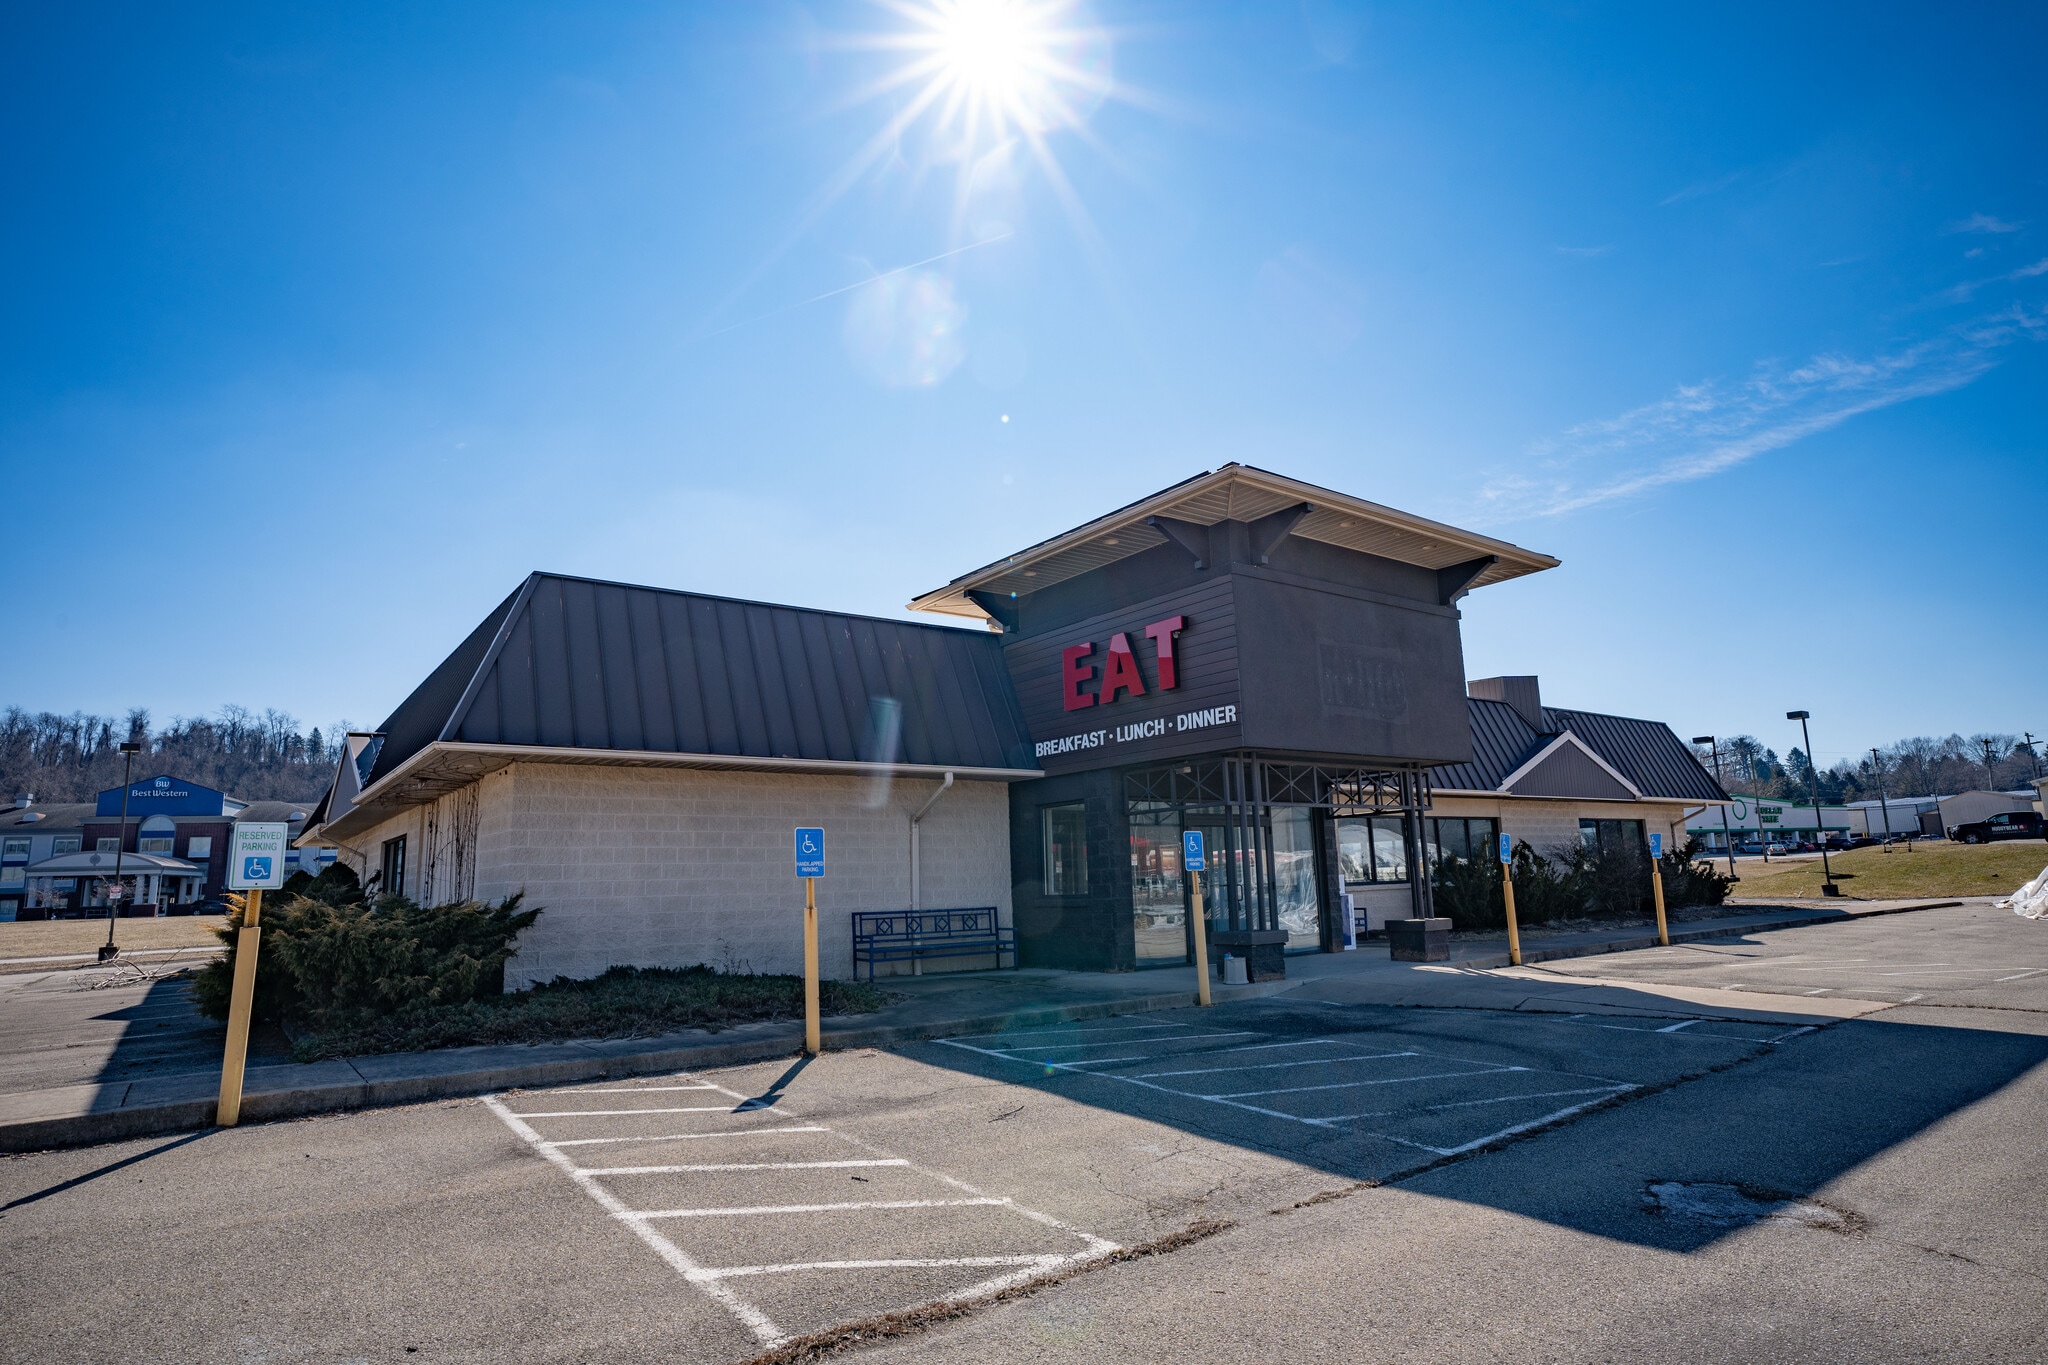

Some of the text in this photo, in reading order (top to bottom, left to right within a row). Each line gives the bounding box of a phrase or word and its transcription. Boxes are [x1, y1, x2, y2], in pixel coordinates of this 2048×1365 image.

[1062, 615, 1184, 711] EAT
[1035, 705, 1237, 758] BREAKFAST LUNCH DINNER
[239, 831, 282, 840] RESERVED
[241, 842, 277, 851] PARKING
